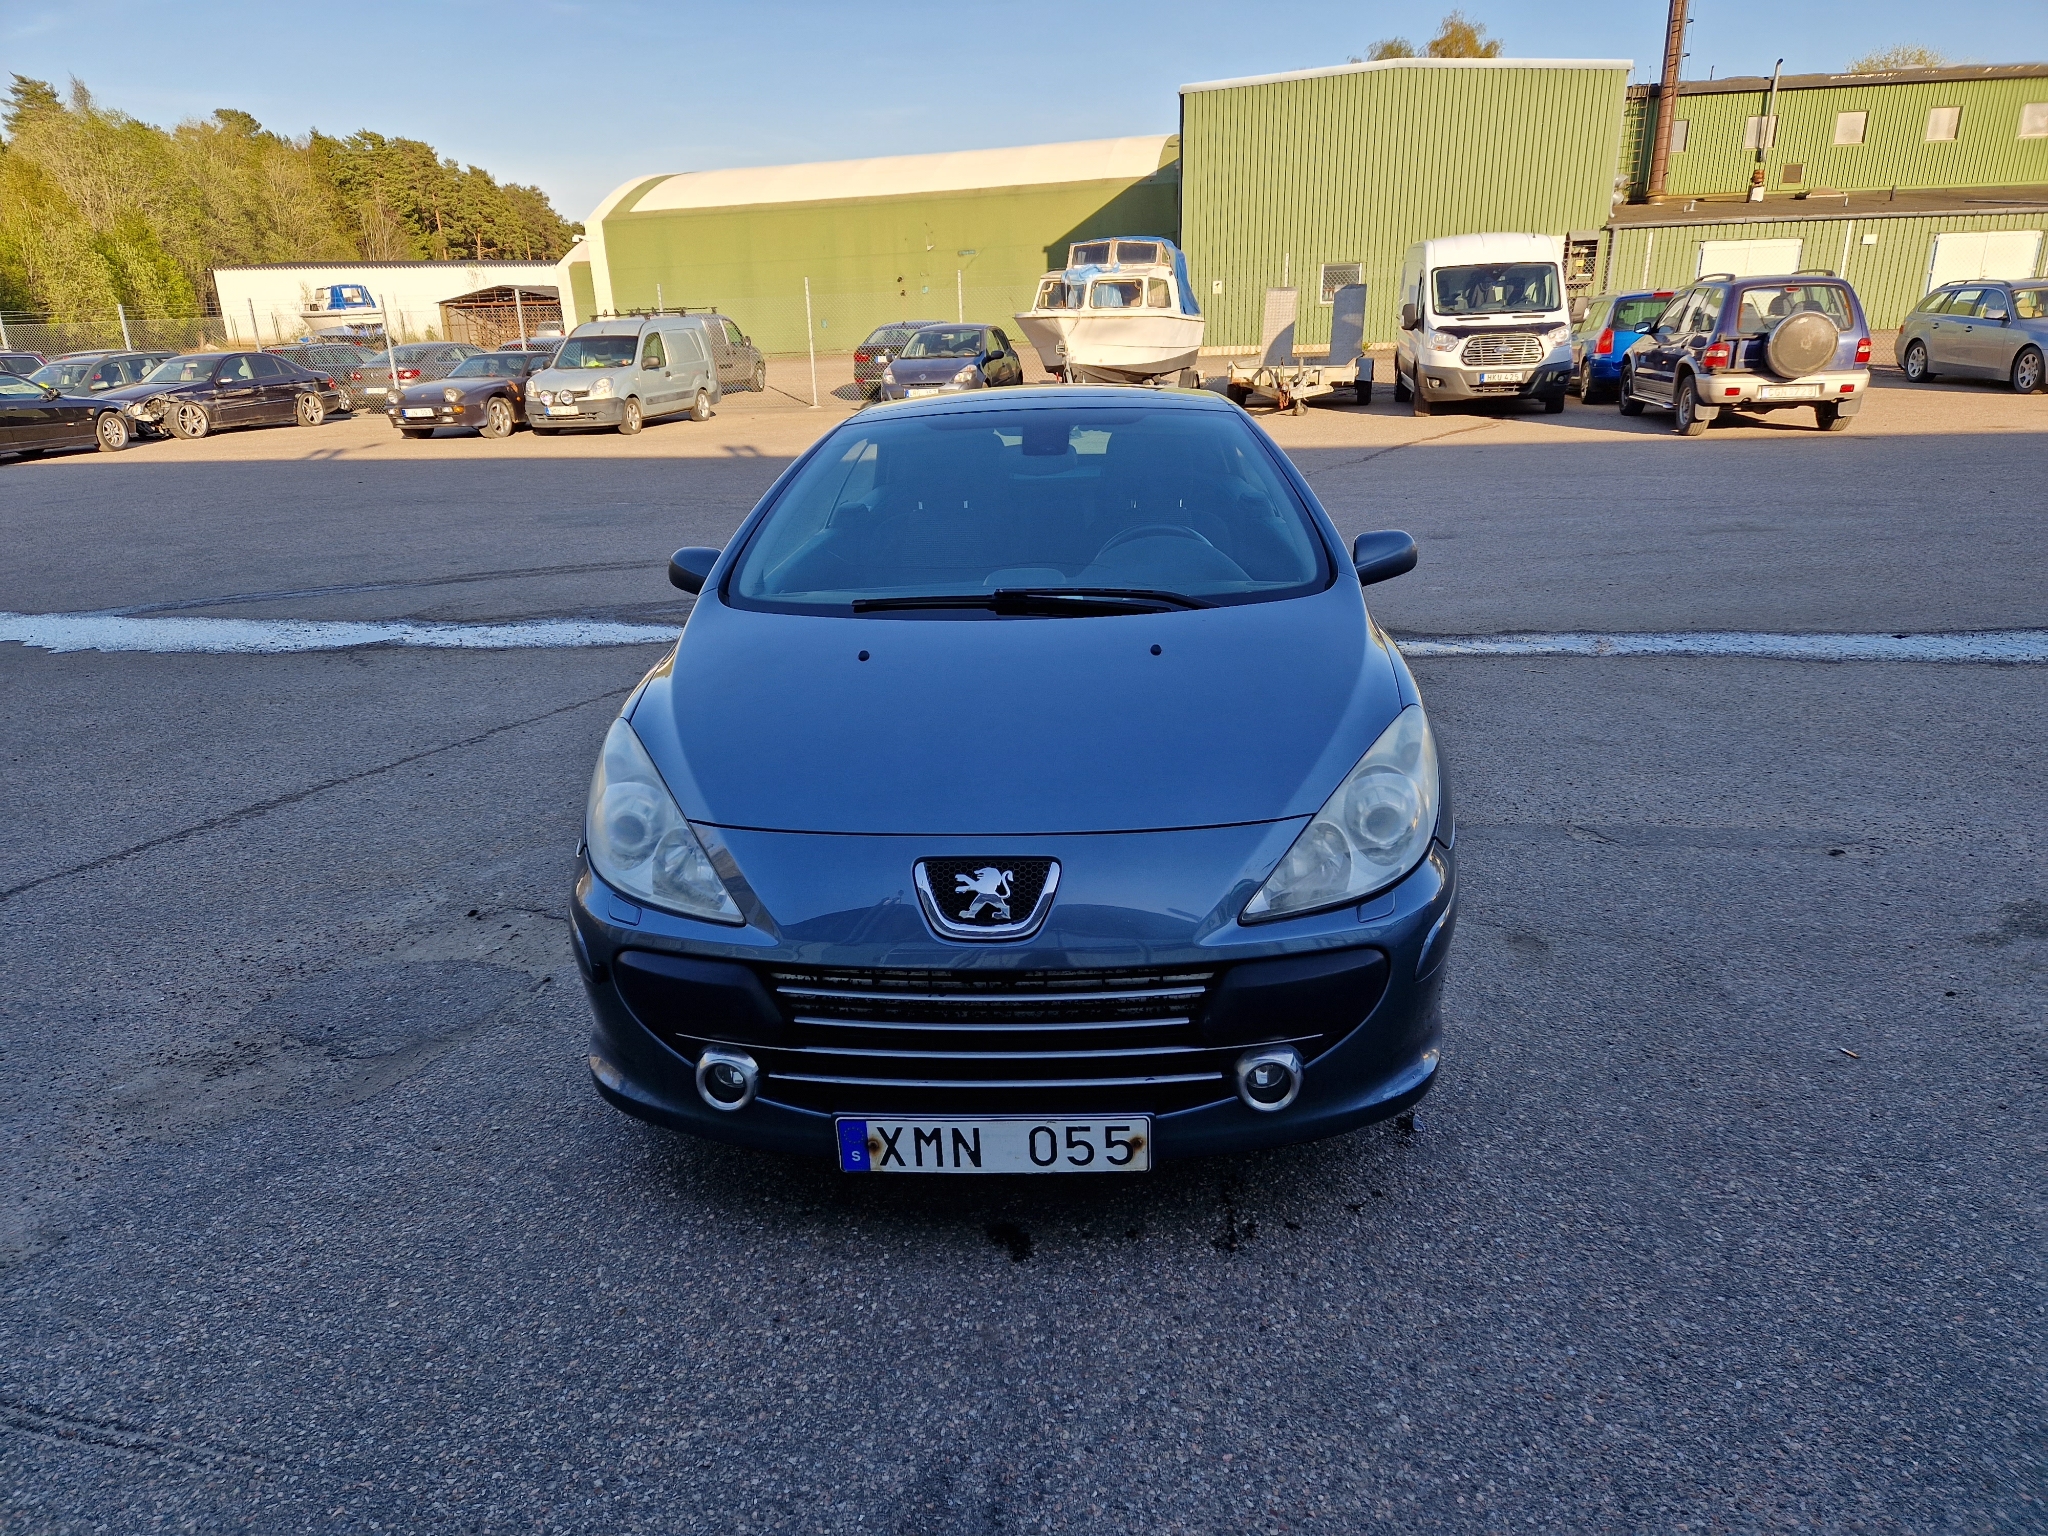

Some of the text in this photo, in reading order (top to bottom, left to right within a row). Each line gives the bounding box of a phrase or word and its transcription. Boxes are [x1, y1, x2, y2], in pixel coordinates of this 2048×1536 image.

[851, 1150, 861, 1162] S
[876, 1125, 1135, 1168] XMN 055
